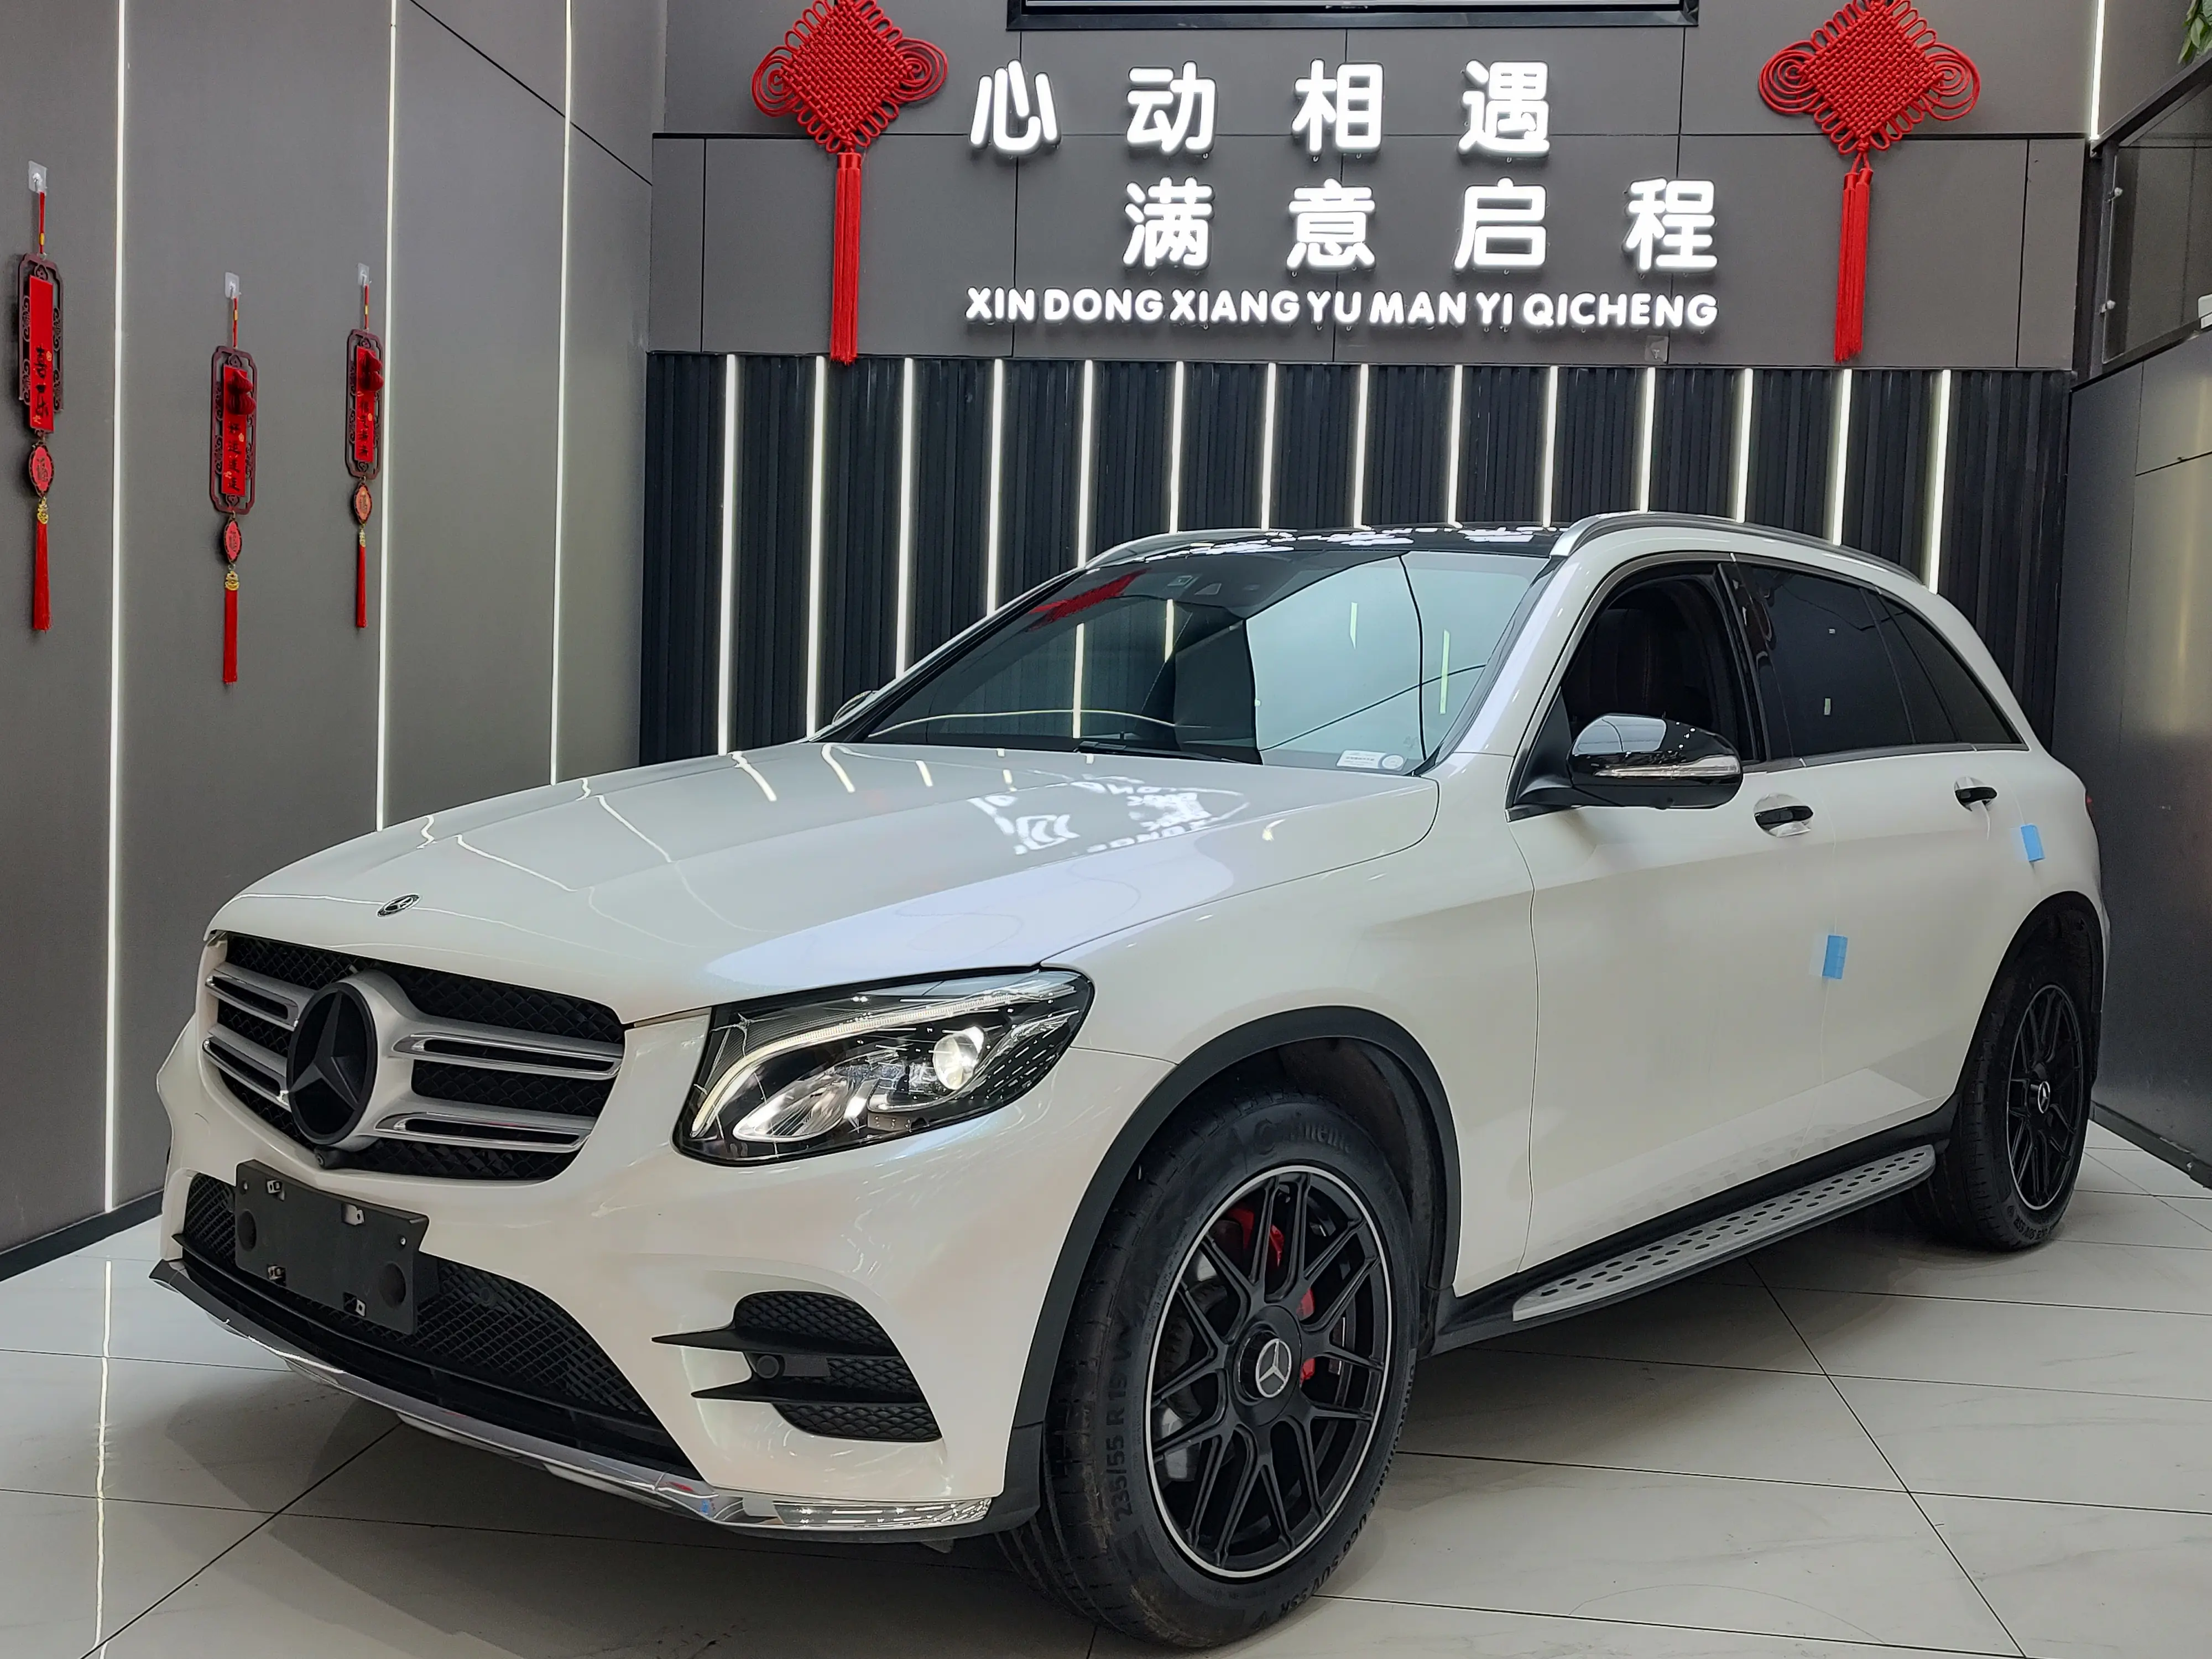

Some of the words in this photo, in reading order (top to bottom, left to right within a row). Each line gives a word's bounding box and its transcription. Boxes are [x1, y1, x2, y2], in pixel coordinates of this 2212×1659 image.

[969, 60, 1550, 153] 心动相遇
[1123, 177, 1718, 270] 满意启程
[966, 287, 1035, 321] XIN
[1044, 288, 1164, 321] DONG
[1169, 289, 1300, 322] XIANG
[1306, 290, 1362, 323] YU
[1369, 291, 1467, 324] MAN
[1475, 291, 1513, 325] YI
[1522, 293, 1718, 327] QICHENG
[1105, 1406, 1126, 1426] R
[1105, 1434, 1133, 1522] 235/55
